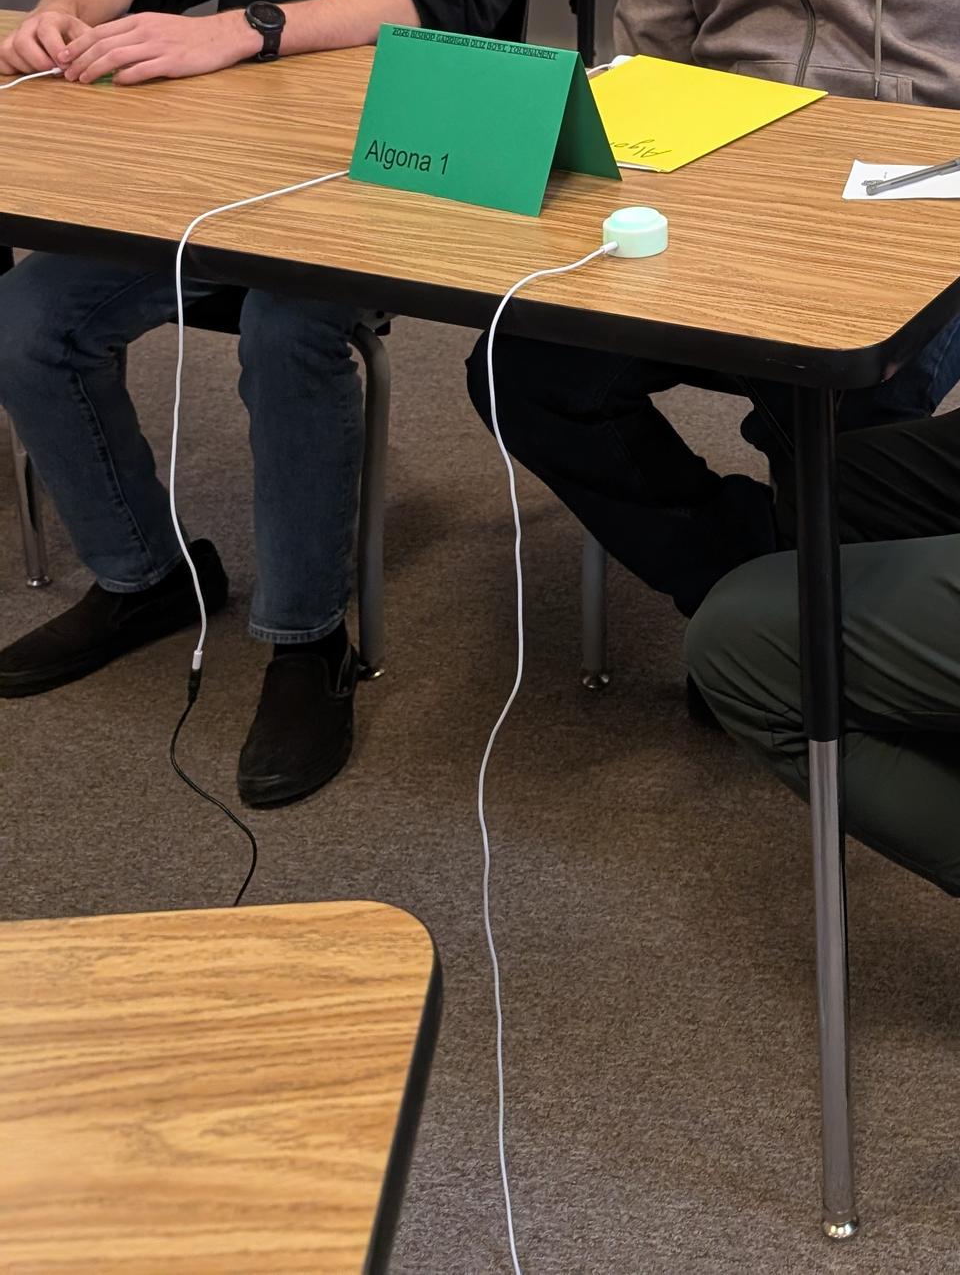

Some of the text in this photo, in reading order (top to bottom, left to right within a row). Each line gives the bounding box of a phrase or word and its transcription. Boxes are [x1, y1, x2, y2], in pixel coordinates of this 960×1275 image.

[410, 30, 435, 41] BISHOP
[470, 39, 486, 49] QUIZ
[508, 45, 559, 60] TOURNAMENT
[365, 139, 449, 175] Algona 1
[610, 139, 673, 158] Algo
